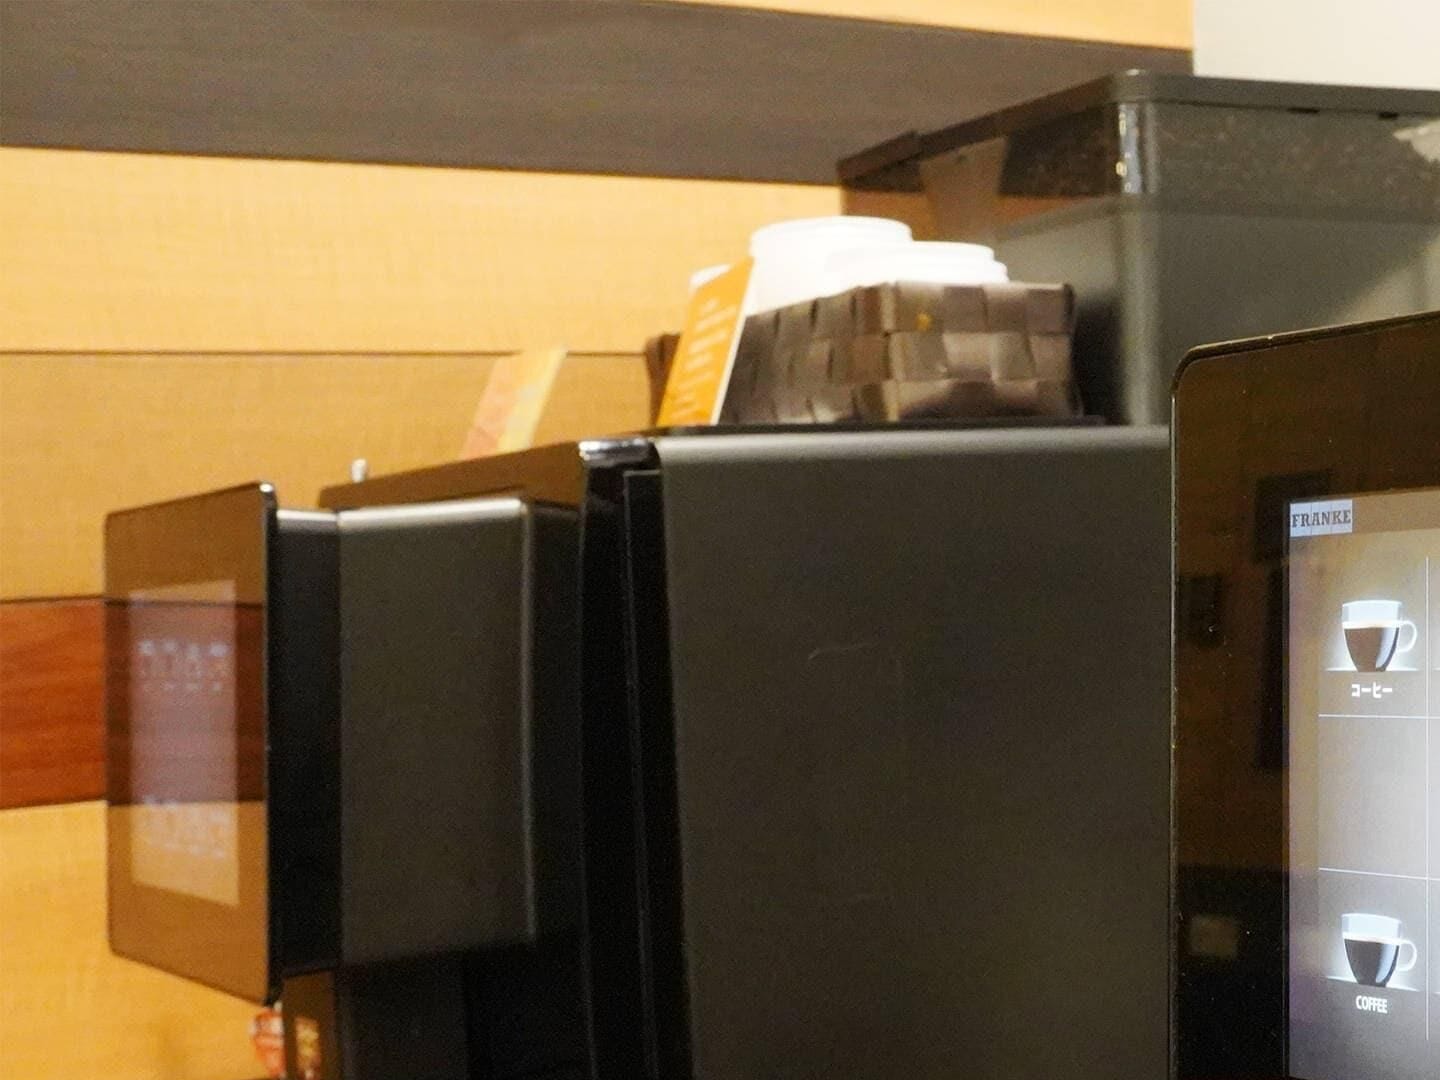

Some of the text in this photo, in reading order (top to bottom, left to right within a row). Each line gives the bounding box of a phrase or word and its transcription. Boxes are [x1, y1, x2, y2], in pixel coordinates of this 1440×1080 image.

[1291, 508, 1352, 529] FRANKE
[1350, 681, 1393, 700] コーヒー
[1355, 994, 1389, 1015] COFFEE
